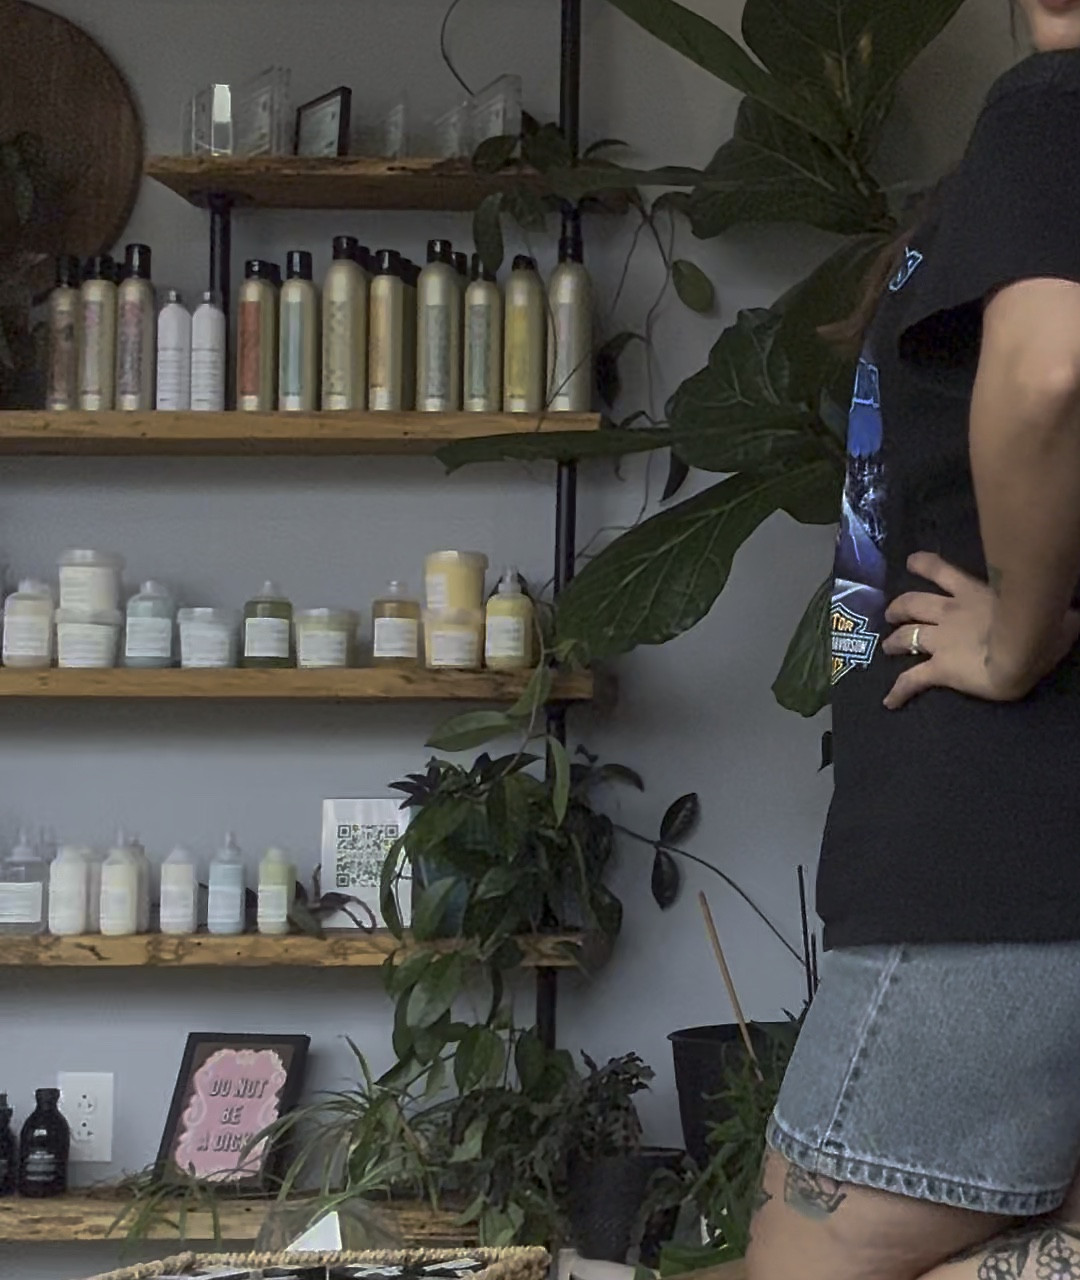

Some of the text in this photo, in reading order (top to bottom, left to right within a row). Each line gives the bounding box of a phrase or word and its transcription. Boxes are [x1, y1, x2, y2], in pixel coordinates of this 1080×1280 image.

[210, 1078, 268, 1098] DO NOT
[222, 1106, 243, 1124] BE
[197, 1132, 208, 1151] A
